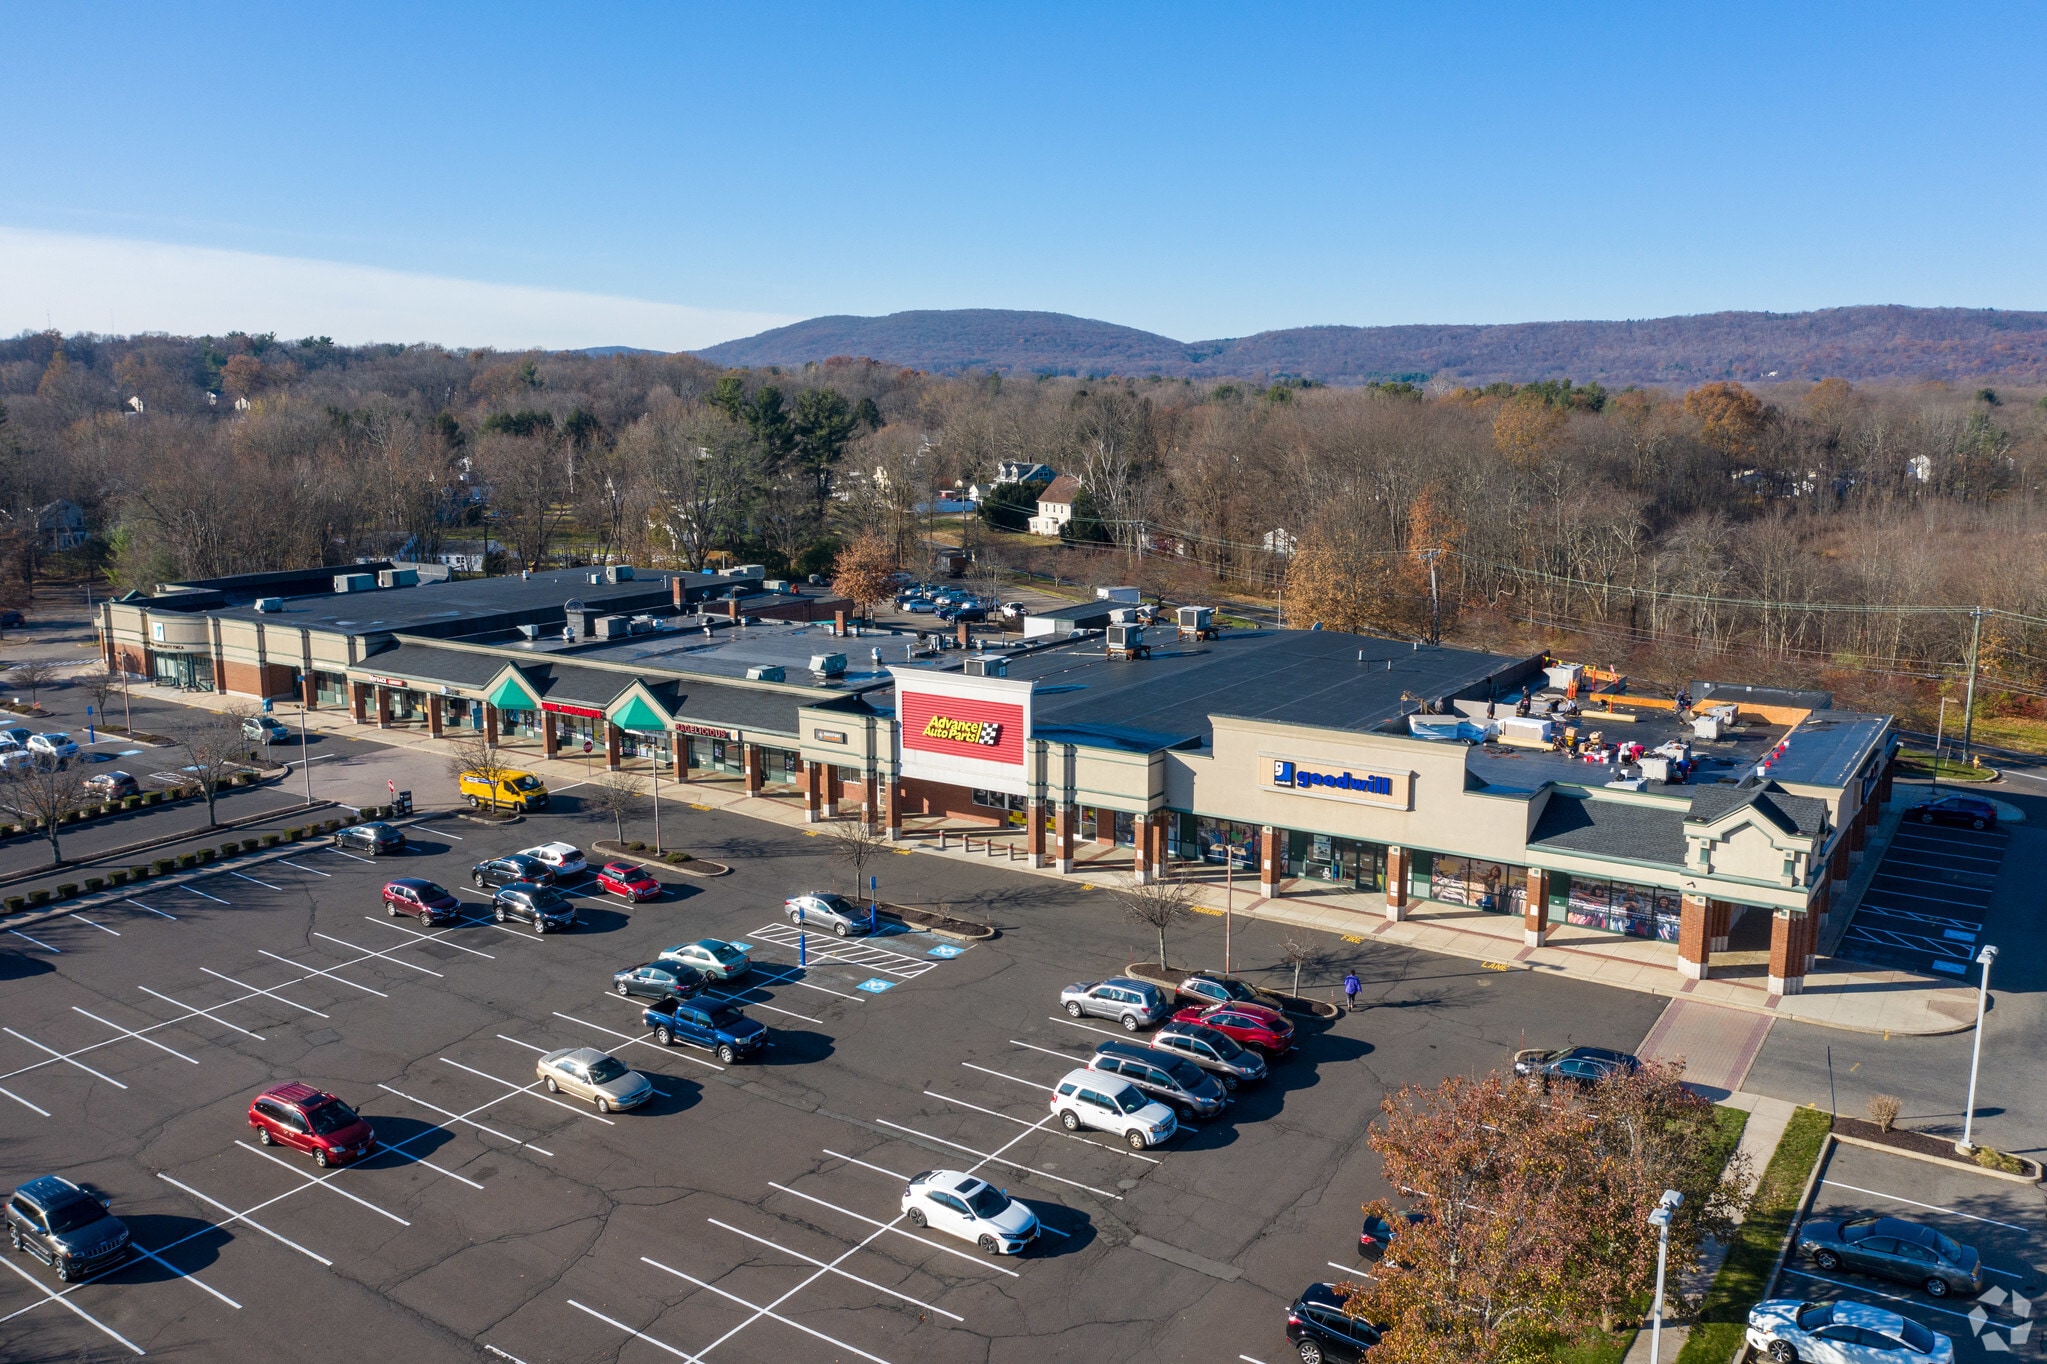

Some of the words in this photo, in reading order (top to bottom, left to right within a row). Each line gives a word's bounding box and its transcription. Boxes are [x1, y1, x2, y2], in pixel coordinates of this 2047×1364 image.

[541, 702, 559, 712] WINE
[560, 705, 602, 719] MERCHANTS
[674, 723, 726, 738] BAGELICIOUS
[928, 715, 978, 733] Advance
[922, 726, 948, 738] Auto
[948, 729, 976, 743] Parts
[1296, 770, 1391, 795] goodwill
[1340, 933, 1364, 945] FIRE
[1480, 961, 1511, 972] LANE
